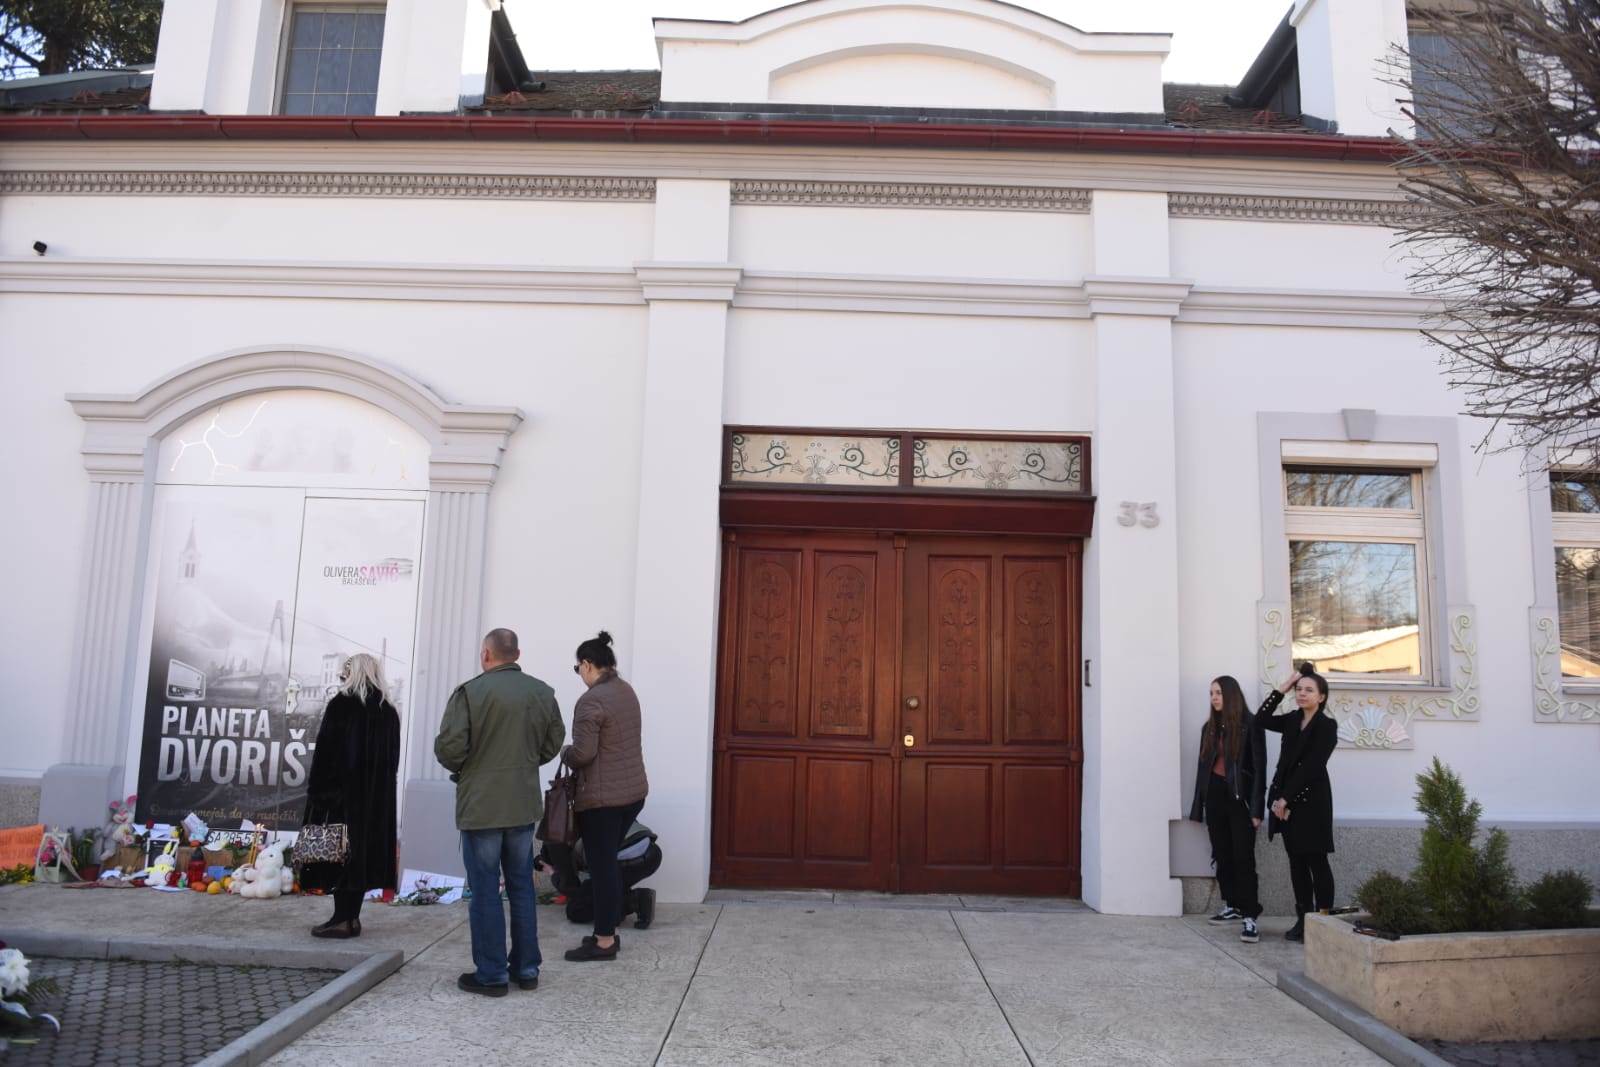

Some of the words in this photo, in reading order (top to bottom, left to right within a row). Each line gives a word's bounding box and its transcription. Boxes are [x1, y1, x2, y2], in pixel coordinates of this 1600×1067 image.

[1117, 501, 1160, 529] 33
[323, 566, 359, 578] OLIVERA
[161, 705, 271, 738] PLANETA
[157, 728, 316, 787] DVORIŠ
